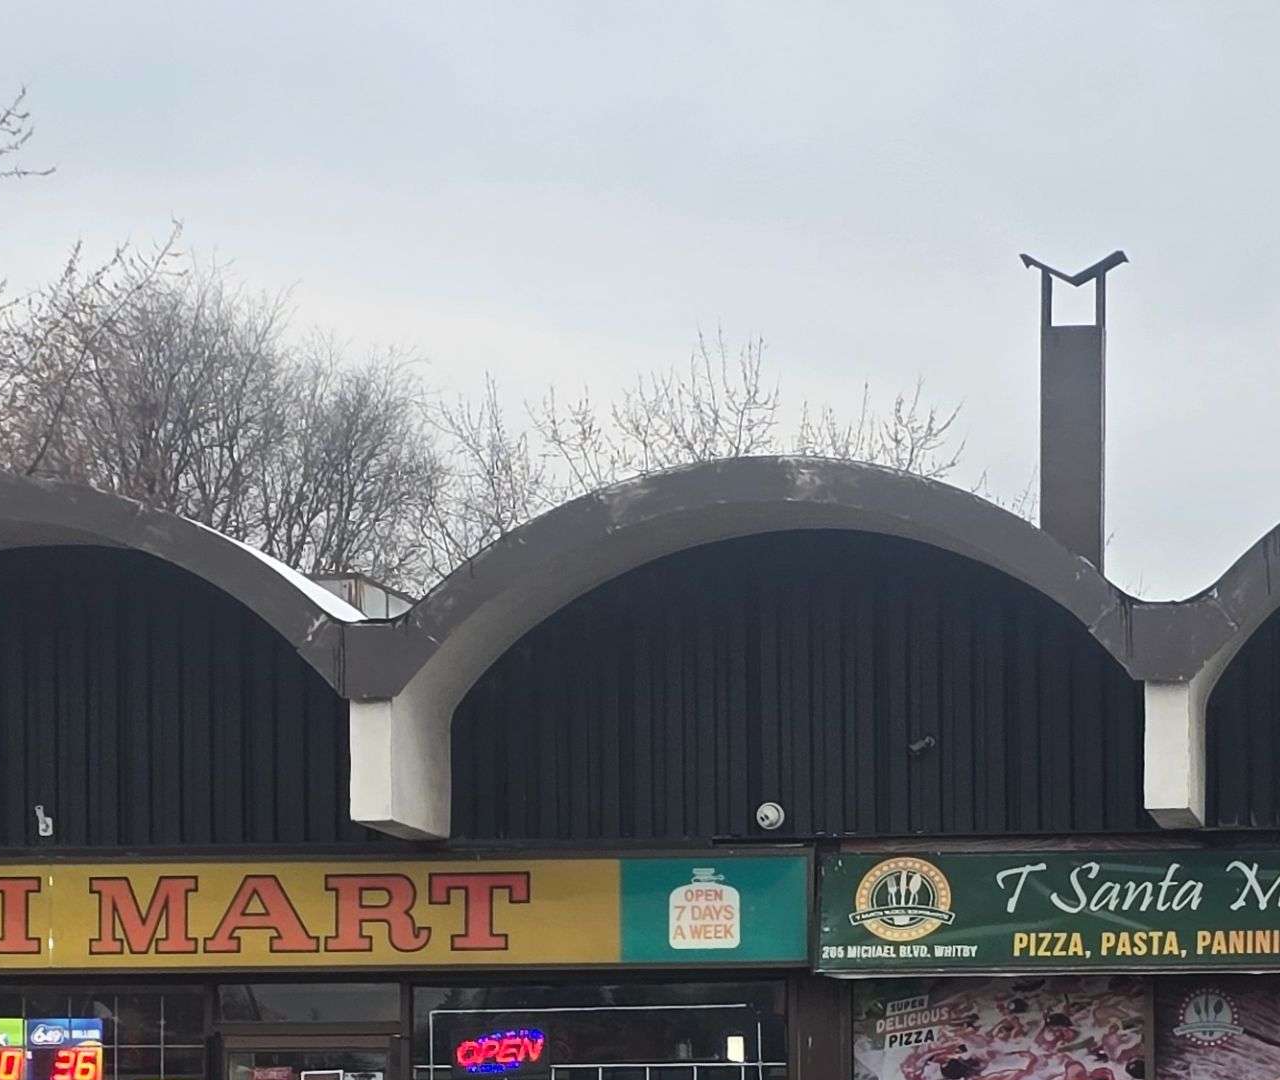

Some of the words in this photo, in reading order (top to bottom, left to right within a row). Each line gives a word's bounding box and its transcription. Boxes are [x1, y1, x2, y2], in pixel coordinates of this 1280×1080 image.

[684, 888, 724, 902] OPEN
[996, 862, 1047, 914] T
[1050, 861, 1204, 914] Santa
[88, 872, 531, 955] MART
[673, 905, 687, 922] 7
[690, 905, 735, 921] DAYS
[672, 925, 686, 940] A
[689, 924, 735, 940] WEEK
[846, 944, 897, 959] MICHAEL
[933, 944, 979, 959] WHITBY
[1013, 932, 1092, 959] PIZZA,
[1100, 931, 1187, 958] PASTA,
[889, 998, 926, 1013] SUPER
[875, 1007, 951, 1035] DELICIOUS
[32, 1026, 64, 1042] 649
[888, 1028, 936, 1049] PIZZA
[456, 1036, 545, 1067] OPEN
